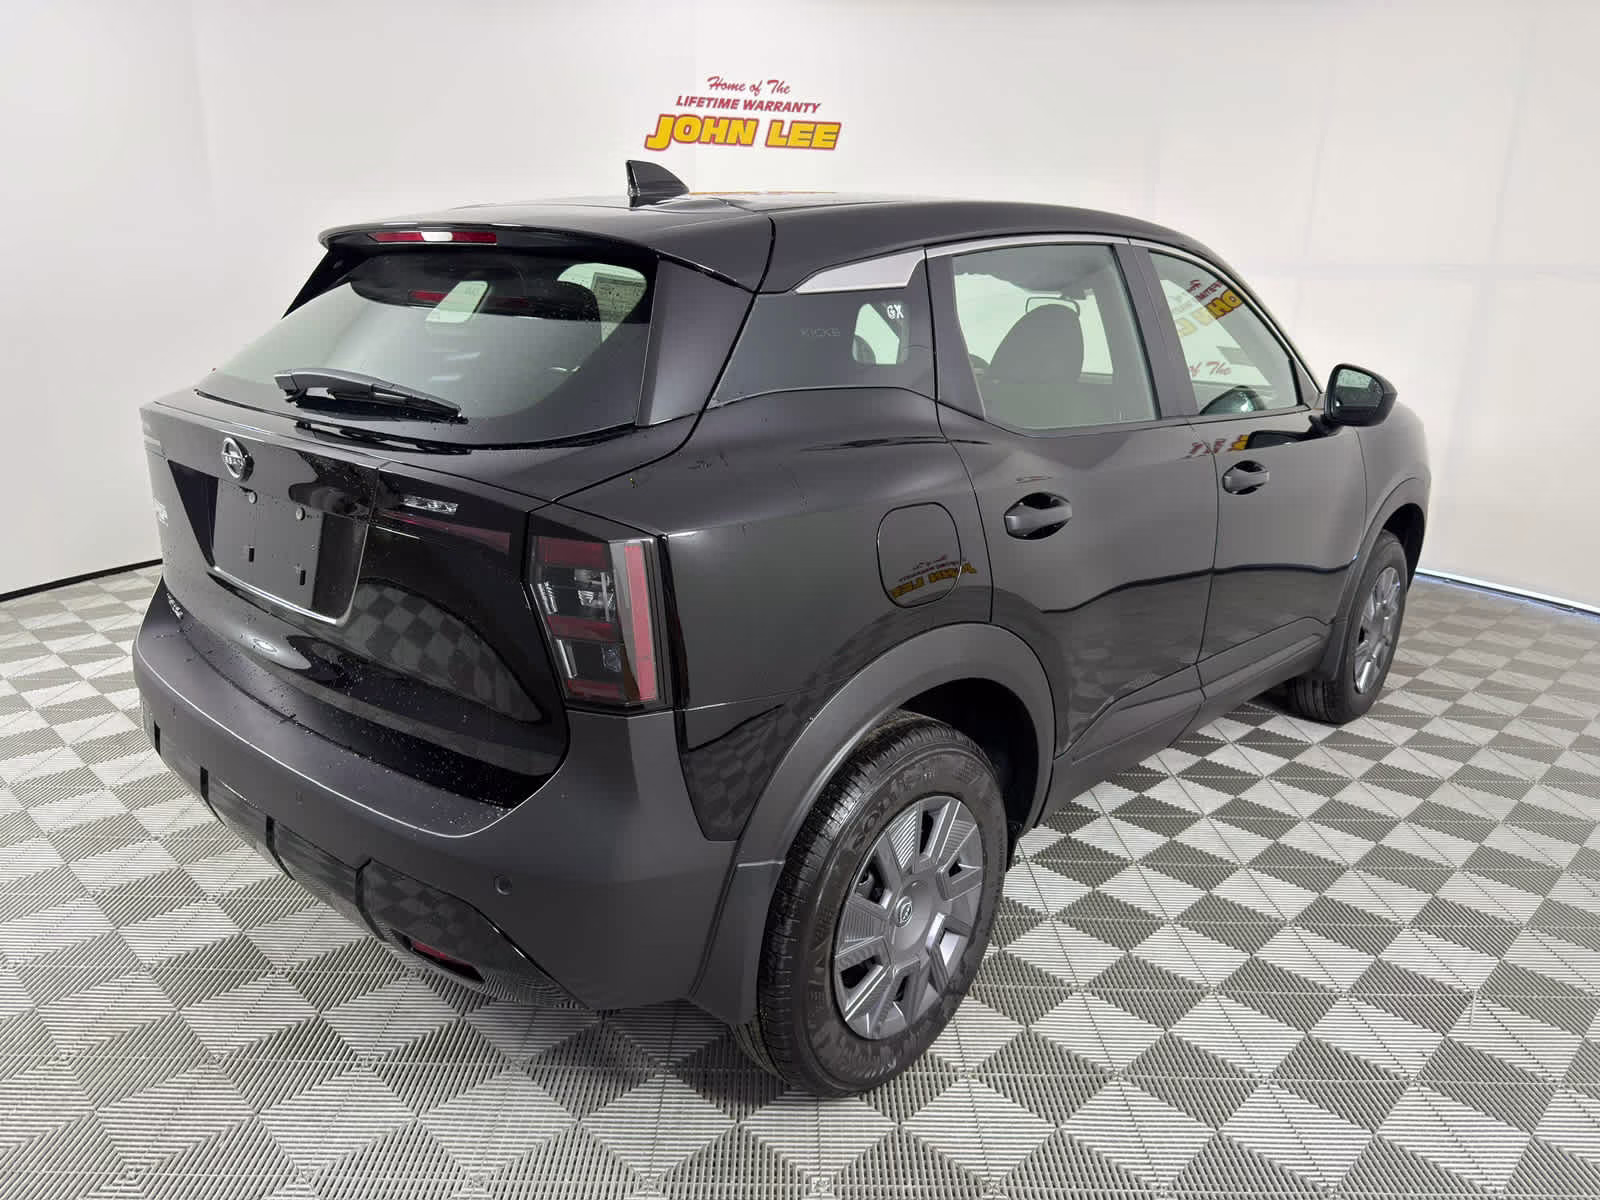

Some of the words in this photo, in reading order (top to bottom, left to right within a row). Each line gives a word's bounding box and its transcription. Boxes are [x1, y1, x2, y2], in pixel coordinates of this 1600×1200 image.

[707, 76, 745, 91] Home
[749, 79, 763, 96] of
[767, 79, 791, 94] The
[676, 95, 740, 110] LIFETIME
[743, 99, 821, 113] WARRANTY
[644, 113, 759, 151] JOHN
[765, 119, 842, 150] LEE
[1206, 361, 1232, 376] The
